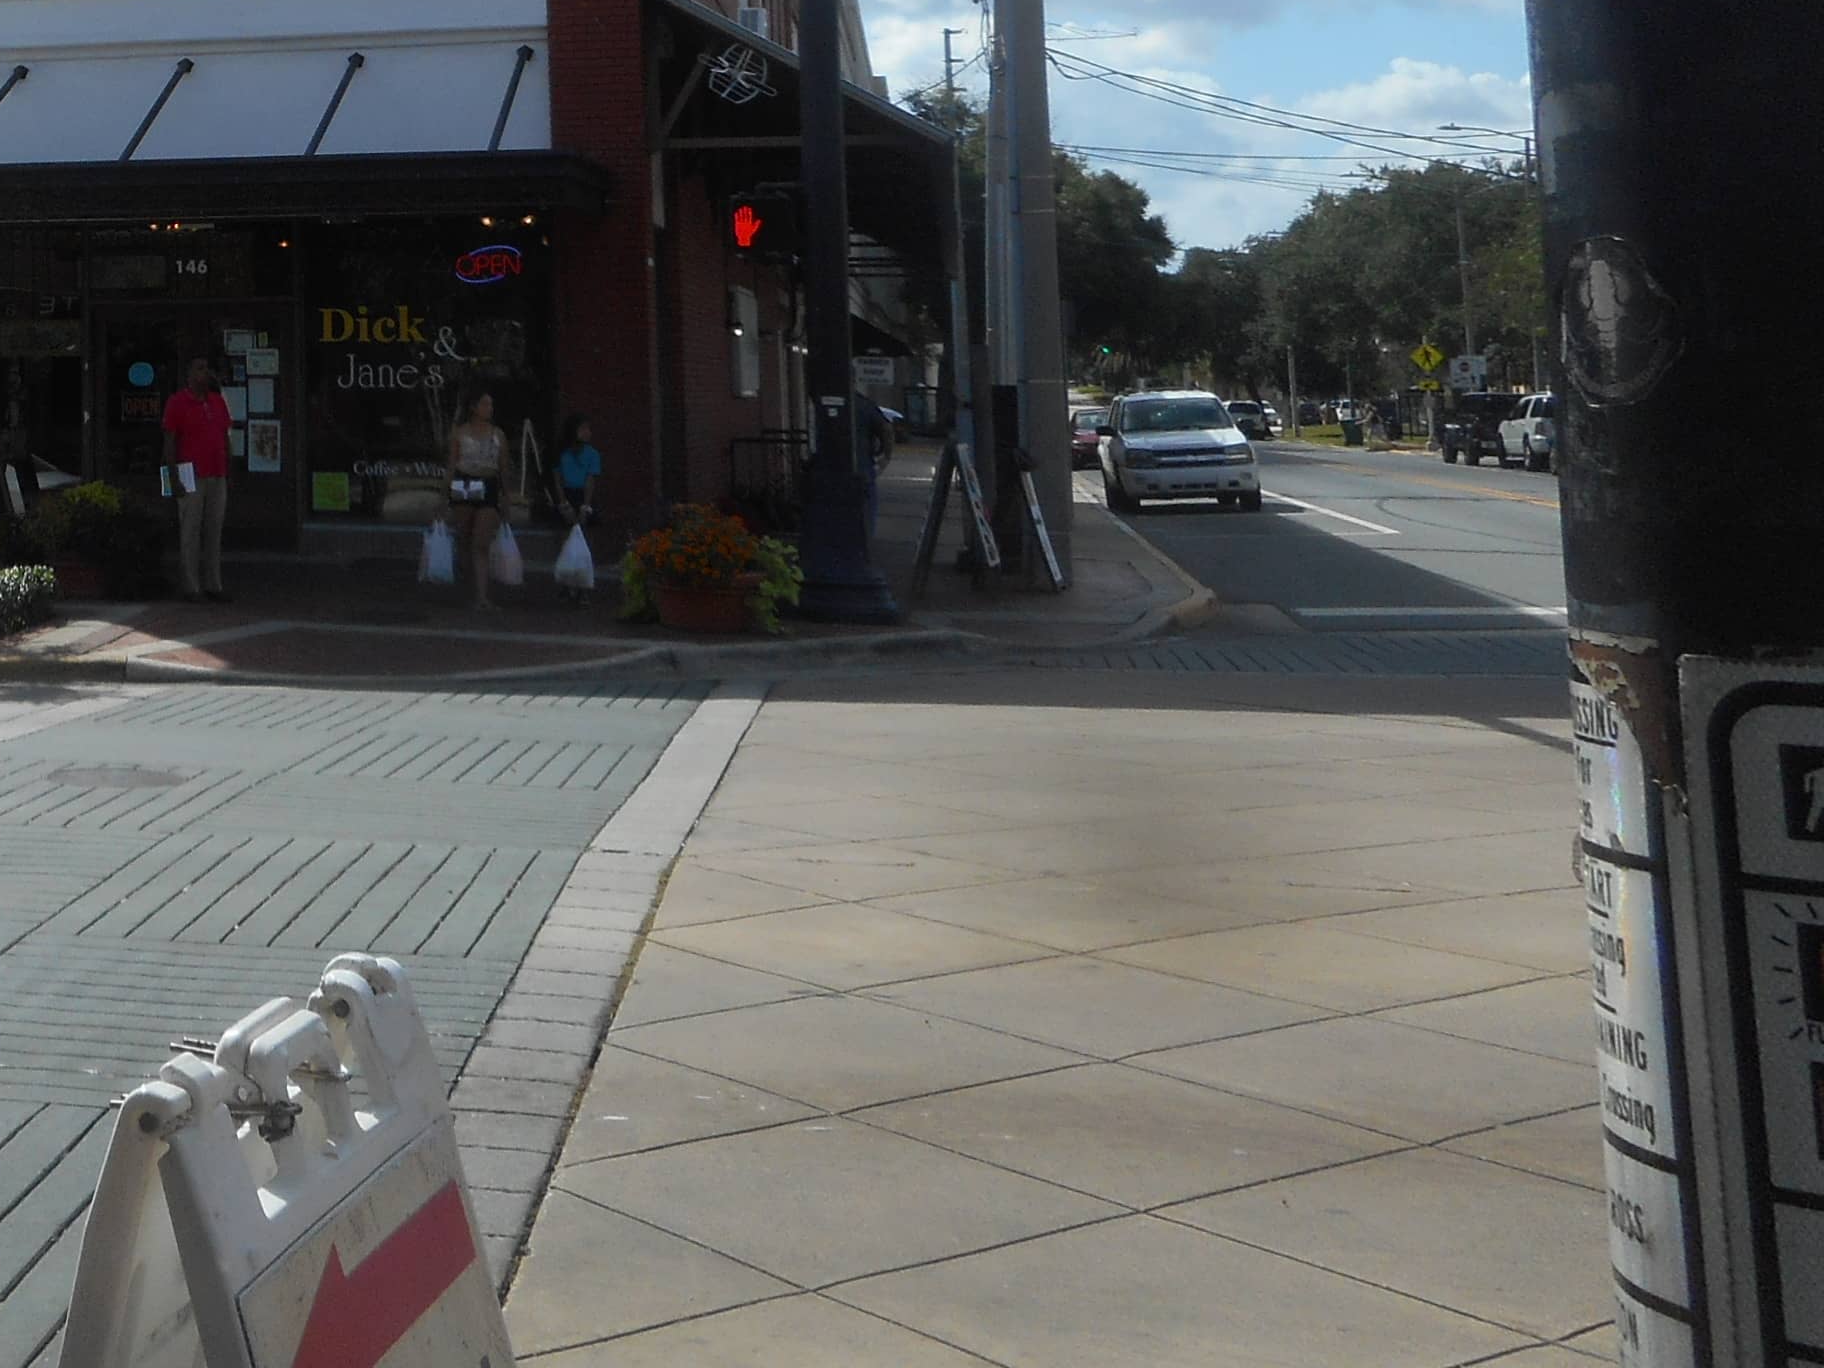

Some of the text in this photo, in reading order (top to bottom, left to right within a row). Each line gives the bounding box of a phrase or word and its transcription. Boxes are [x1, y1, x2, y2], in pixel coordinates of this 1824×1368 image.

[174, 258, 209, 275] 146
[455, 252, 525, 277] OPEN
[318, 303, 466, 361] Dick &
[336, 350, 445, 390] Jane's
[352, 458, 400, 475] Coffee
